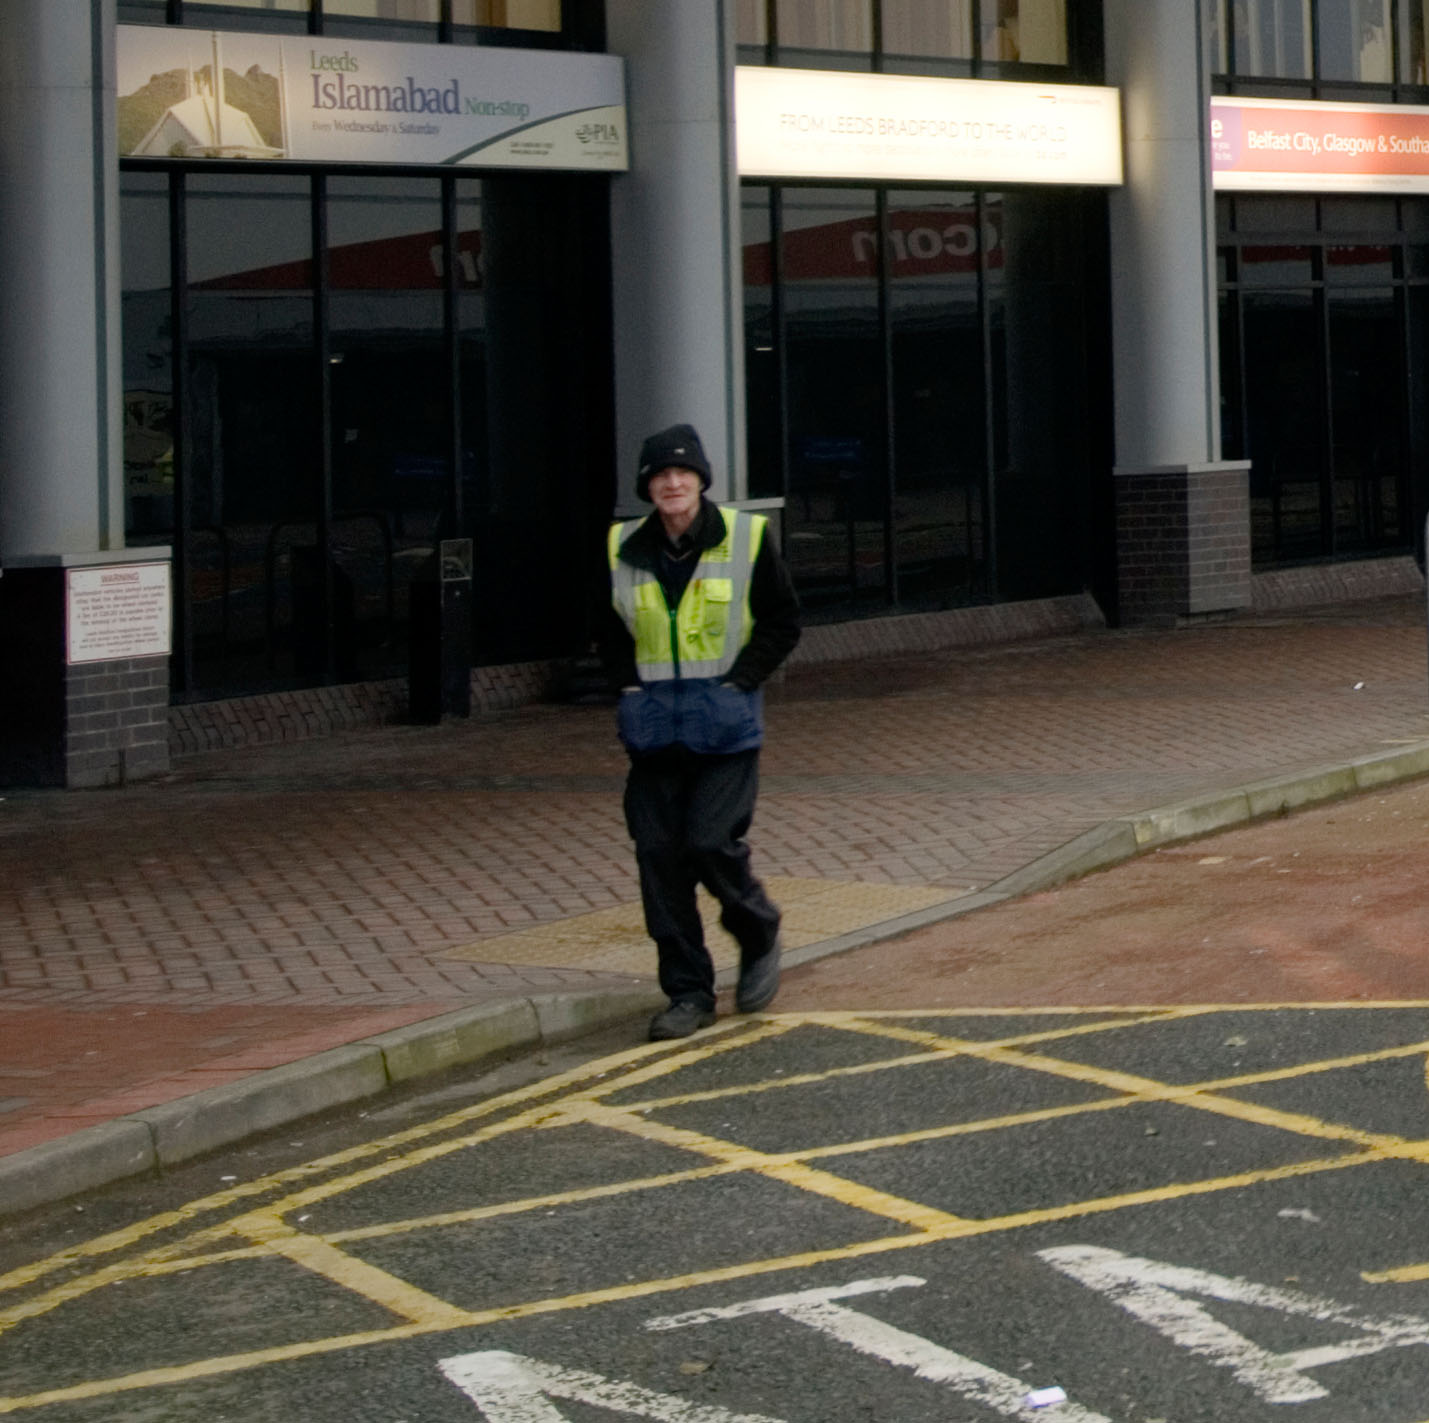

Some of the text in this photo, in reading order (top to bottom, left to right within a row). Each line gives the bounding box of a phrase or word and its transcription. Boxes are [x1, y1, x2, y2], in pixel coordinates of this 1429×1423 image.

[310, 49, 359, 73] Leeds
[311, 74, 531, 119] Islamabad Non-stop
[334, 119, 389, 134] Wednesday
[399, 122, 440, 136] Saturday
[593, 124, 619, 141] PIA
[779, 112, 1067, 143] FROM LEEDS BRADFORD TO THE WORLD
[1247, 130, 1291, 150] Belfast
[1292, 131, 1322, 156] City,
[1323, 133, 1376, 157] Glasgow
[1377, 136, 1388, 153] &
